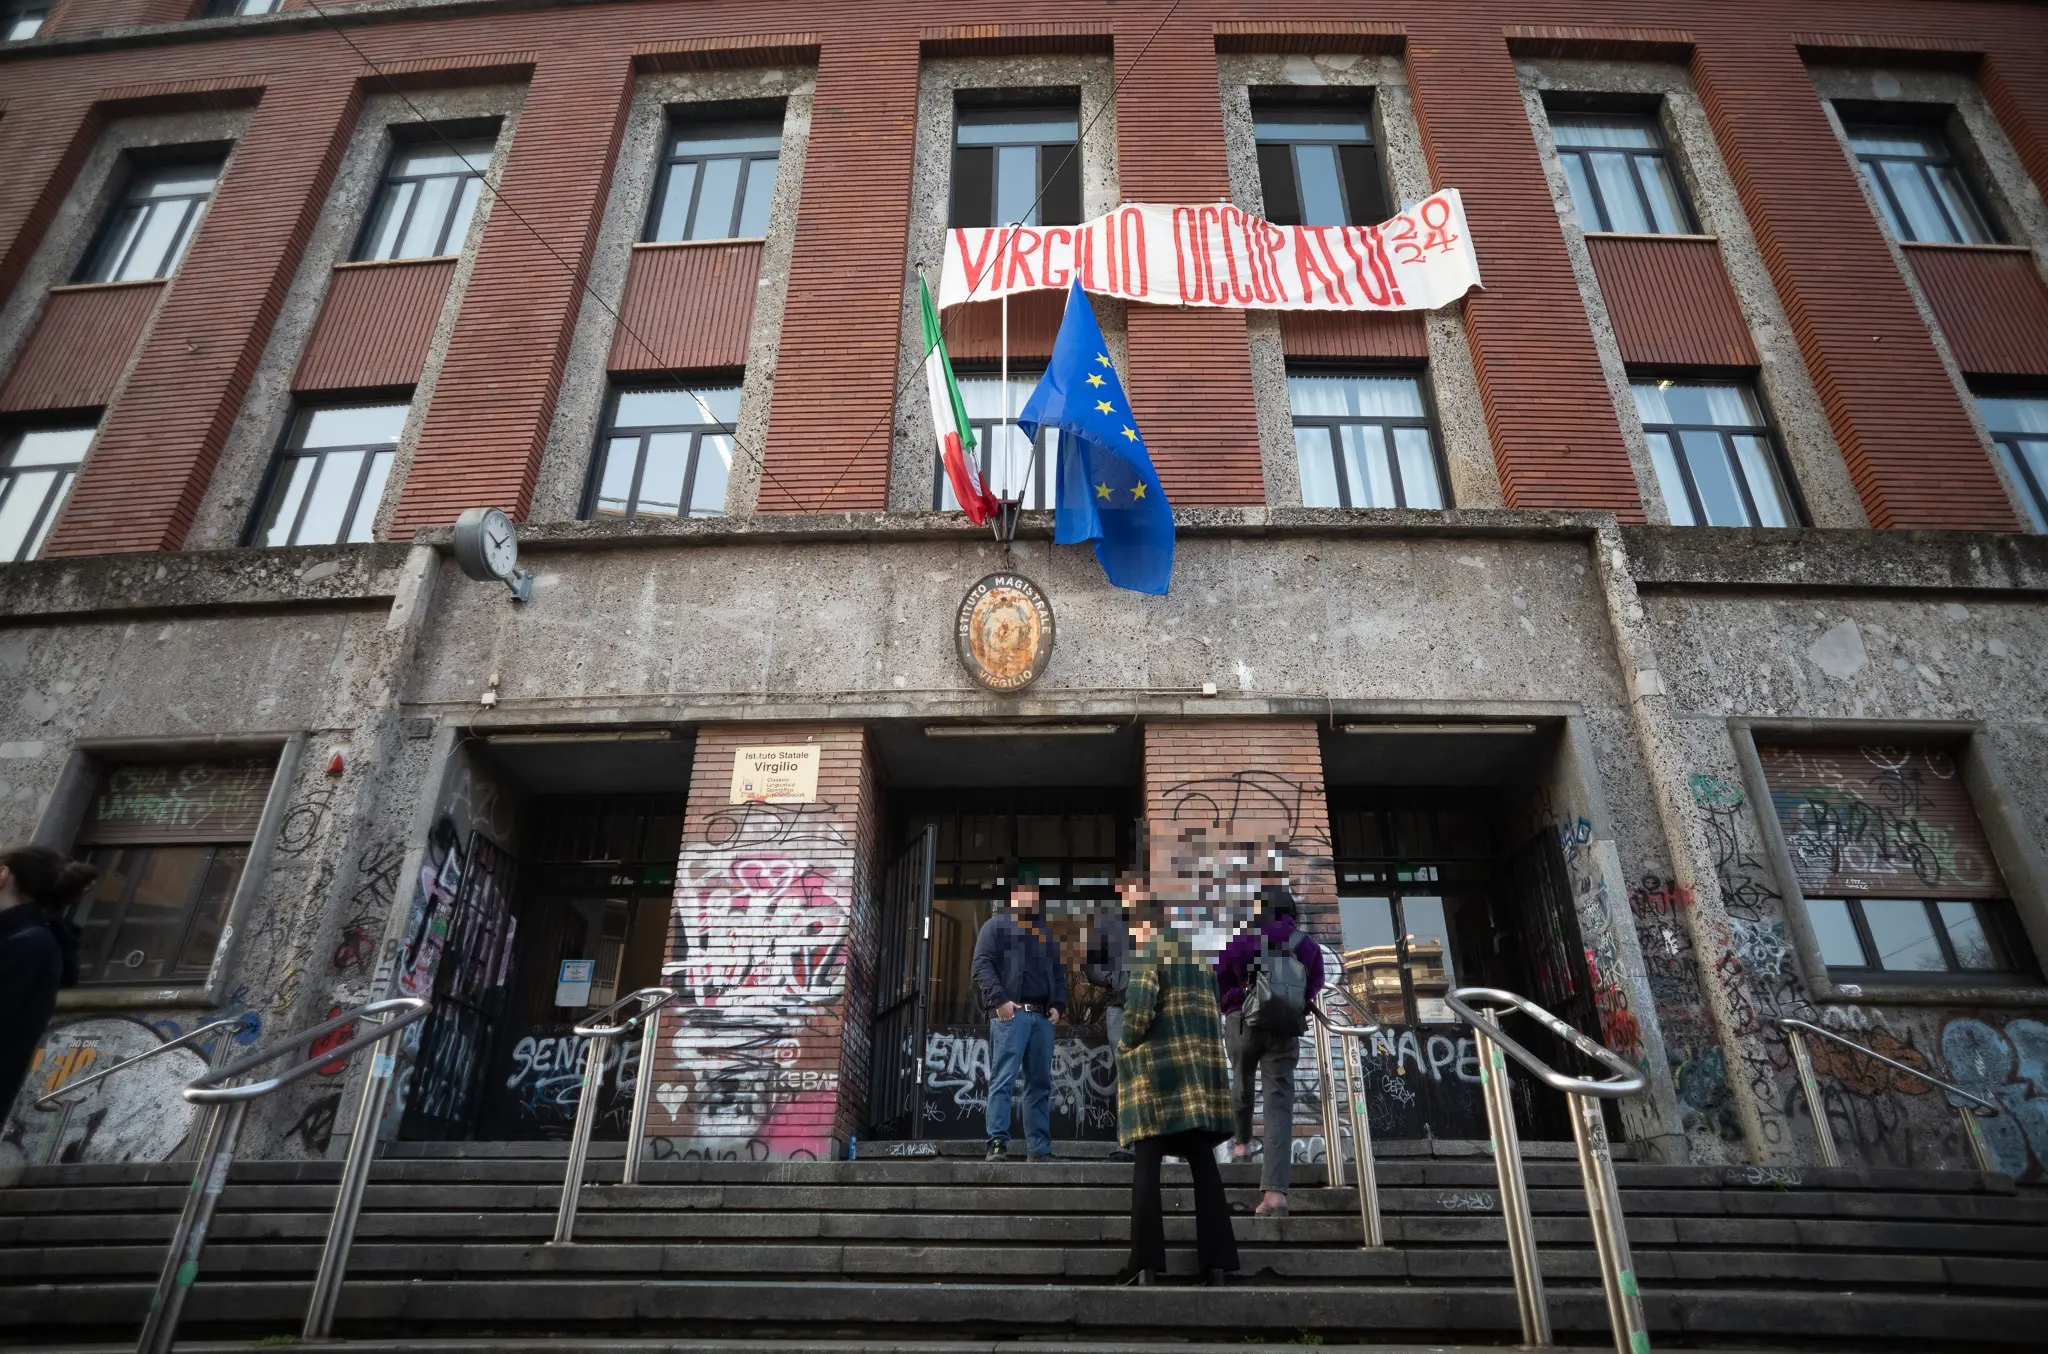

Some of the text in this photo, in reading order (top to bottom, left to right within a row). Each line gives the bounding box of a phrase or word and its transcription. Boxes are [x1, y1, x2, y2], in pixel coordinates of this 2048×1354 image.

[955, 207, 1148, 297] VIRGILIO
[959, 576, 1052, 637] ISTITUTO MAGISTRALE
[980, 669, 1033, 688] VIRGILIO
[745, 751, 809, 760] Isttuto Statale
[754, 761, 798, 774] Virgilio
